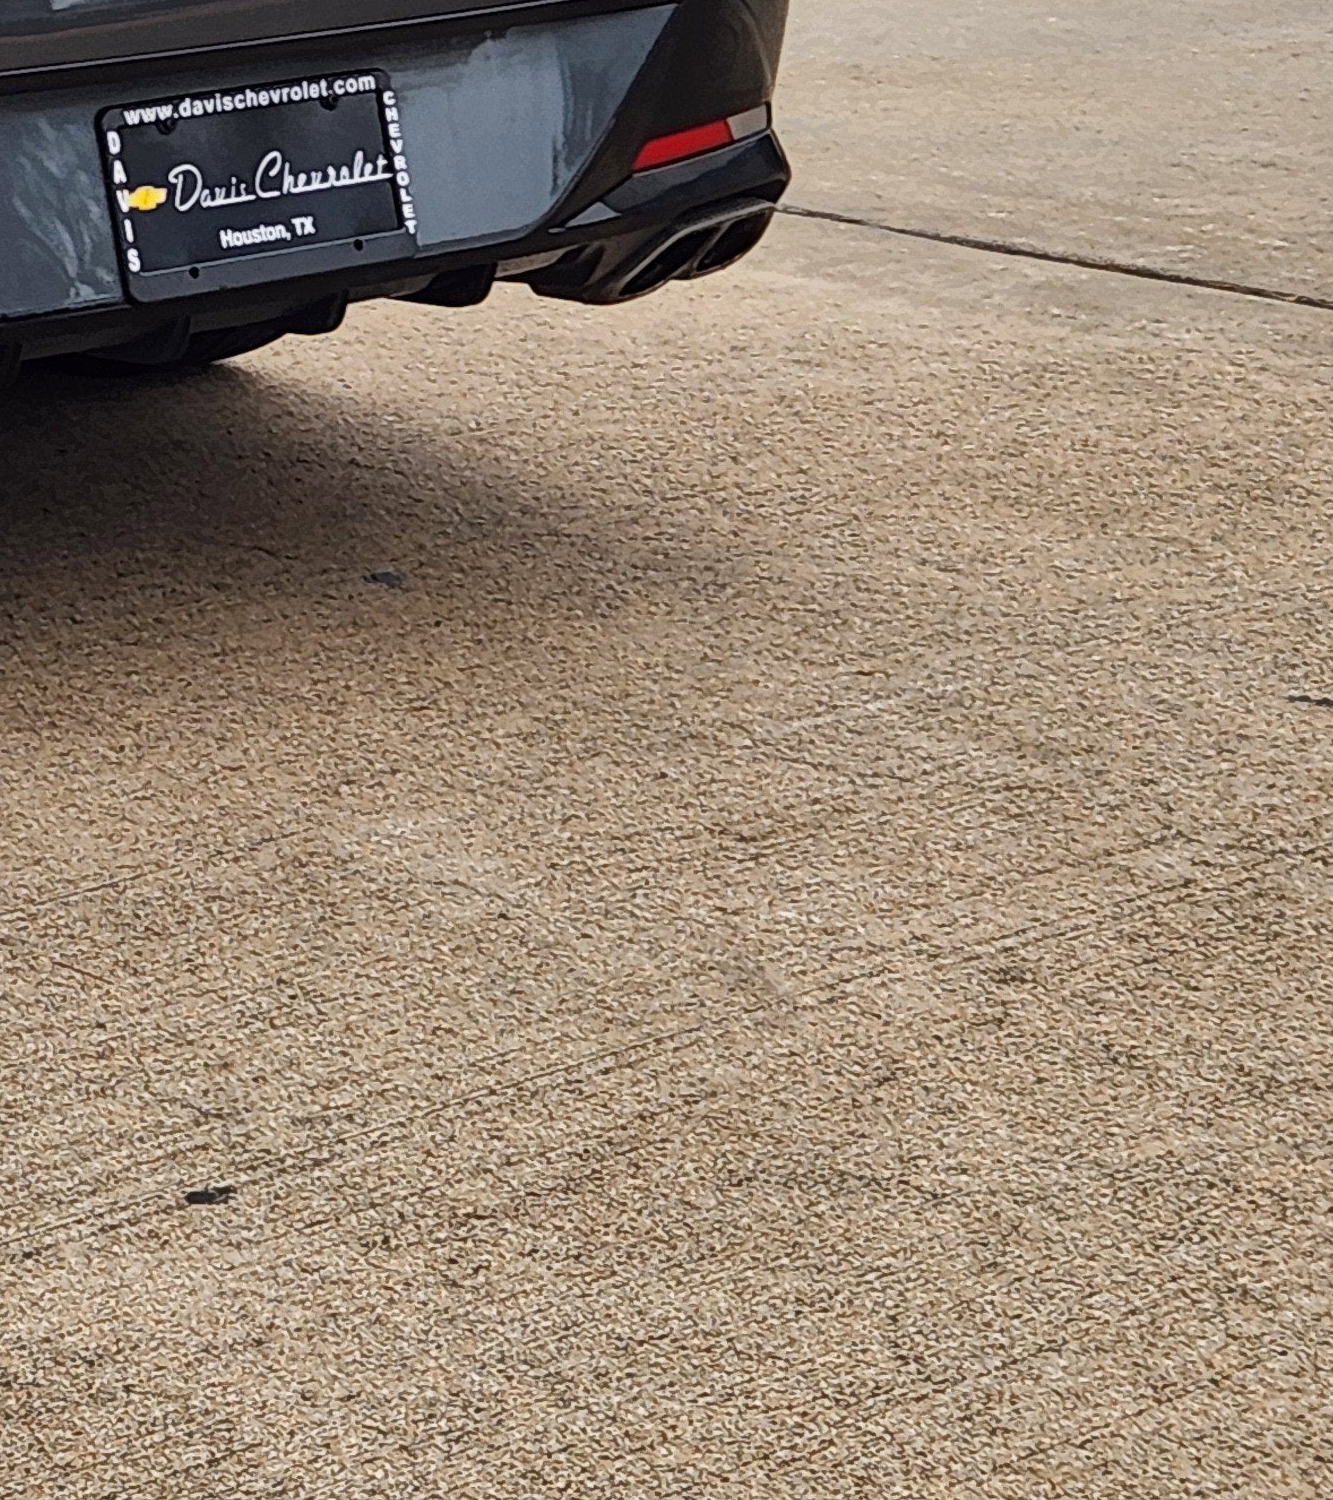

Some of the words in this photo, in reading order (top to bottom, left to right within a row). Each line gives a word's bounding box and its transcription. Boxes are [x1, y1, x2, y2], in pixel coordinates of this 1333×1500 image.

[123, 74, 376, 126] www.davischevrolet.com
[167, 163, 257, 212] Davis
[254, 150, 395, 198] Chevrolet
[382, 90, 417, 235] CHEVROLET
[106, 130, 140, 273] DAVIS
[219, 223, 291, 249] Houston,
[291, 216, 316, 236] TX
